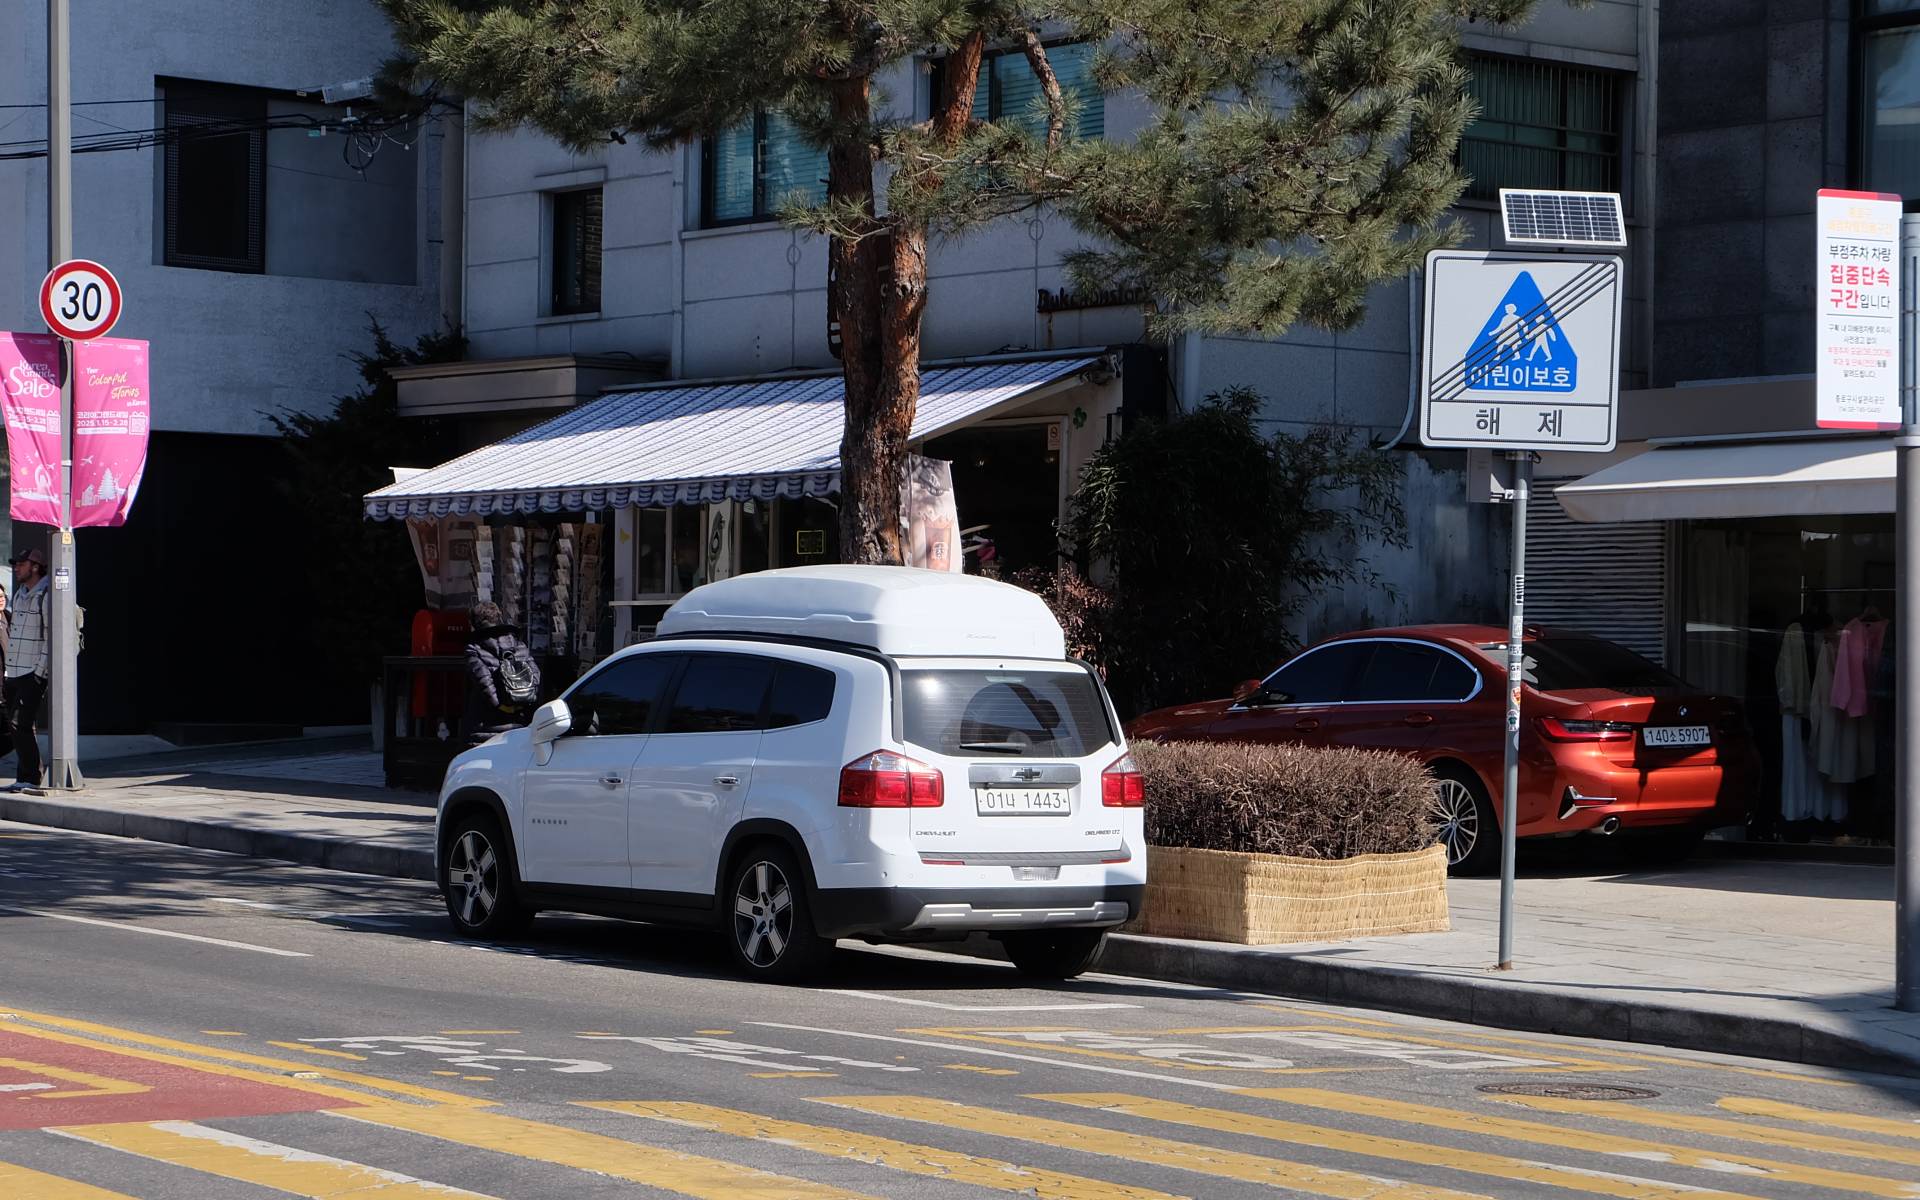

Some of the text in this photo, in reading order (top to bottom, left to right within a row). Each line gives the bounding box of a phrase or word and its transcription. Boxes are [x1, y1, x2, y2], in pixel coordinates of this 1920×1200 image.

[1829, 244, 1891, 262] 부정주차 차량
[1830, 264, 1890, 287] 집중단속
[61, 281, 102, 321] 30
[1830, 289, 1891, 310] 구간입니다
[8, 366, 54, 398] Sale
[1471, 365, 1571, 388] 어린이보호
[1024, 792, 1062, 809] 1443
